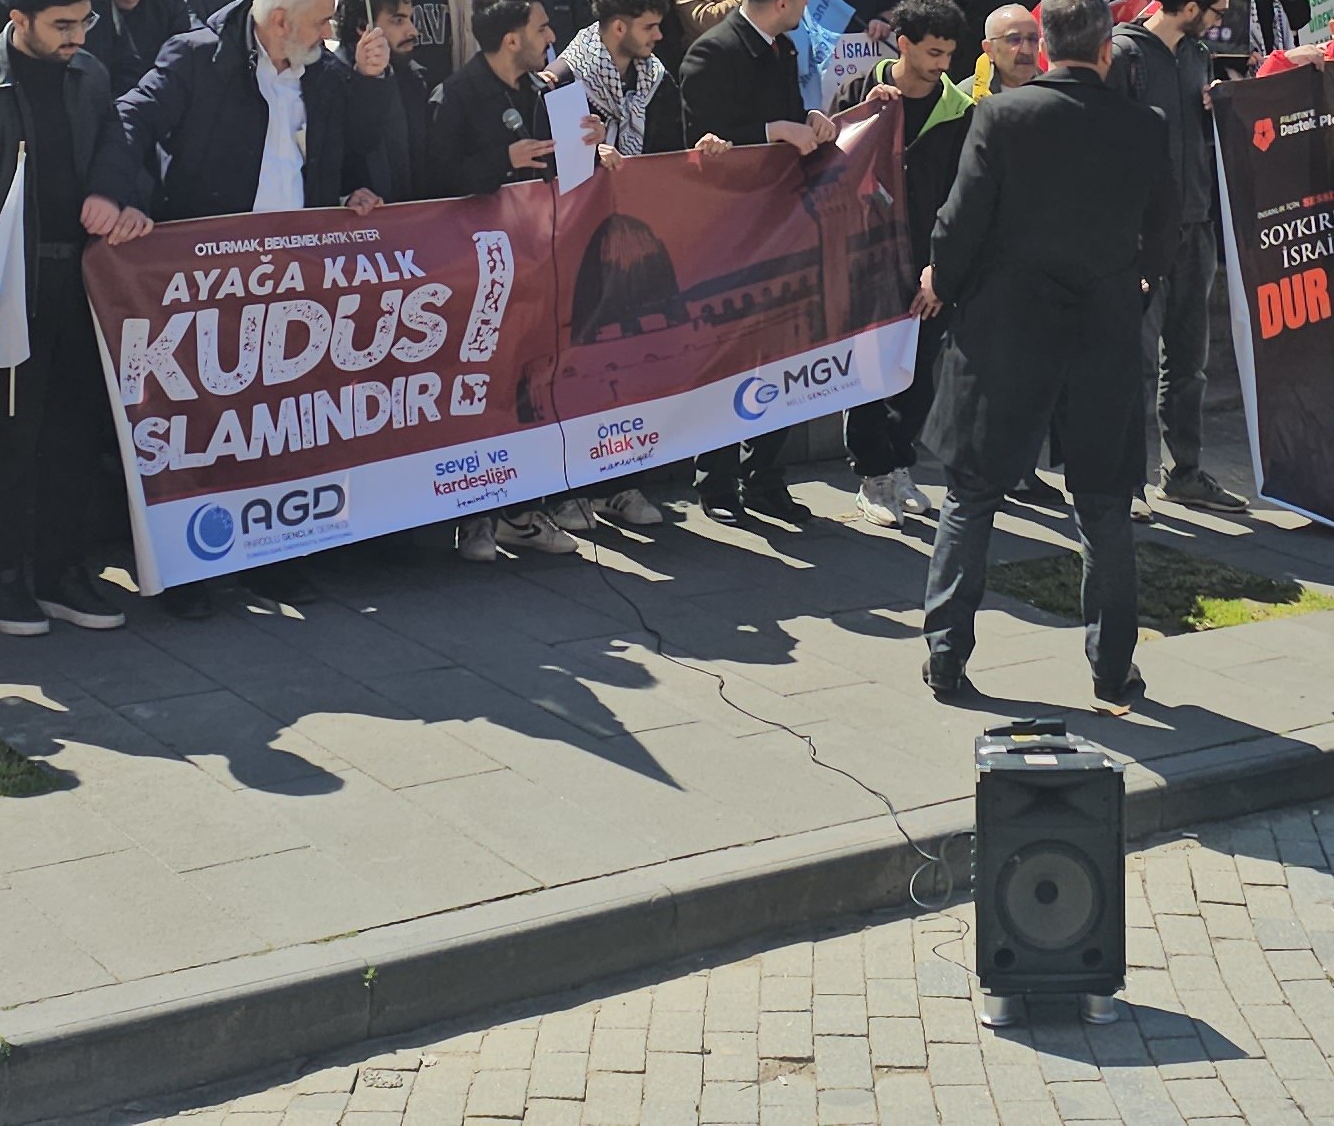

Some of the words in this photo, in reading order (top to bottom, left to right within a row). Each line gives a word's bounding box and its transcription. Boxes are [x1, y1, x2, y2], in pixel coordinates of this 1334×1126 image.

[1280, 118, 1317, 137] Destek
[263, 233, 320, 251] BEKLEMEK
[349, 229, 381, 243] YETER
[161, 254, 306, 306] AYAĞA
[322, 249, 427, 289] KALK
[1257, 267, 1332, 340] DUR
[783, 349, 853, 395] MGV
[127, 371, 443, 477] SLAMINDIR
[597, 416, 645, 440] önce
[435, 450, 480, 476] sevgi
[486, 447, 510, 463] ve
[589, 434, 634, 461] ahlak
[636, 430, 661, 447] ve
[433, 465, 518, 497] kardeşliğin
[240, 483, 347, 535] AGD
